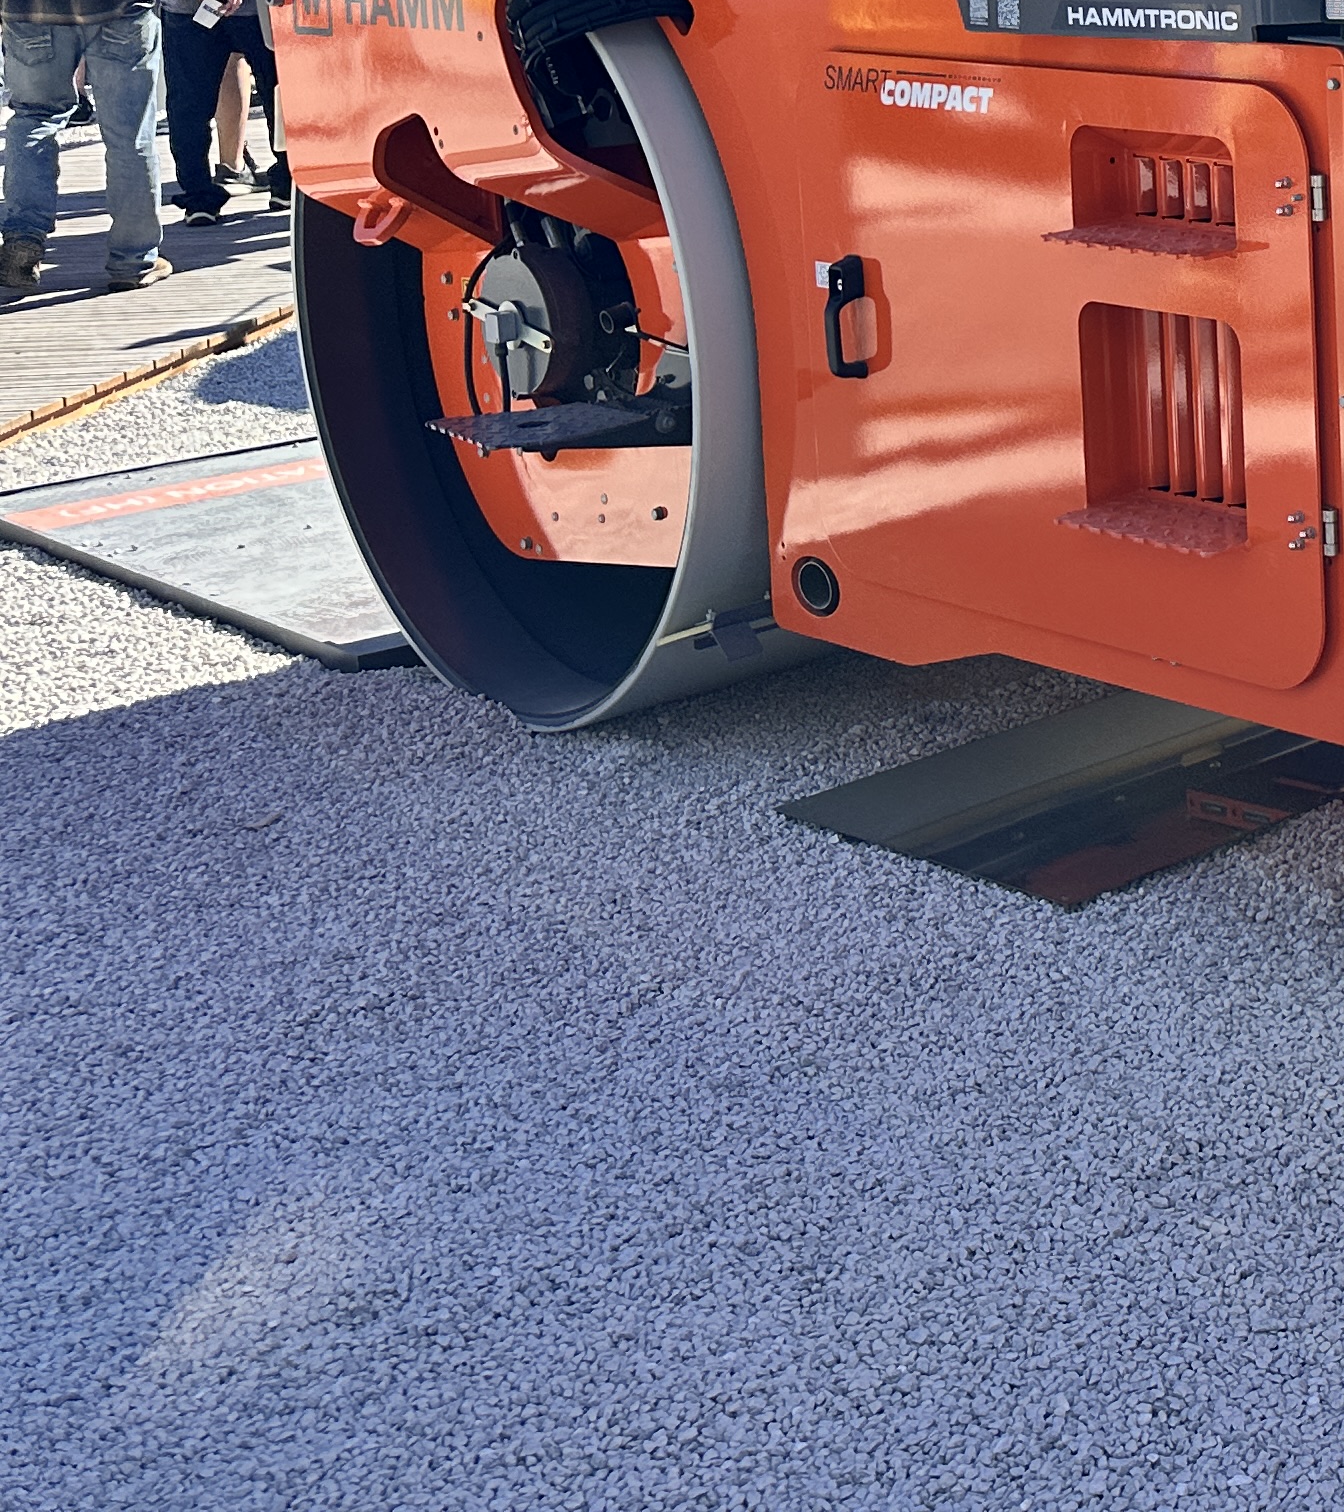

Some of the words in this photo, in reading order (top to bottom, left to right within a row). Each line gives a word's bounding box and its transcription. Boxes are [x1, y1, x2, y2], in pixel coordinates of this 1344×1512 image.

[1067, 5, 1239, 32] HAMMTRONIC
[824, 65, 892, 94] SMART
[880, 78, 994, 114] COMPACT
